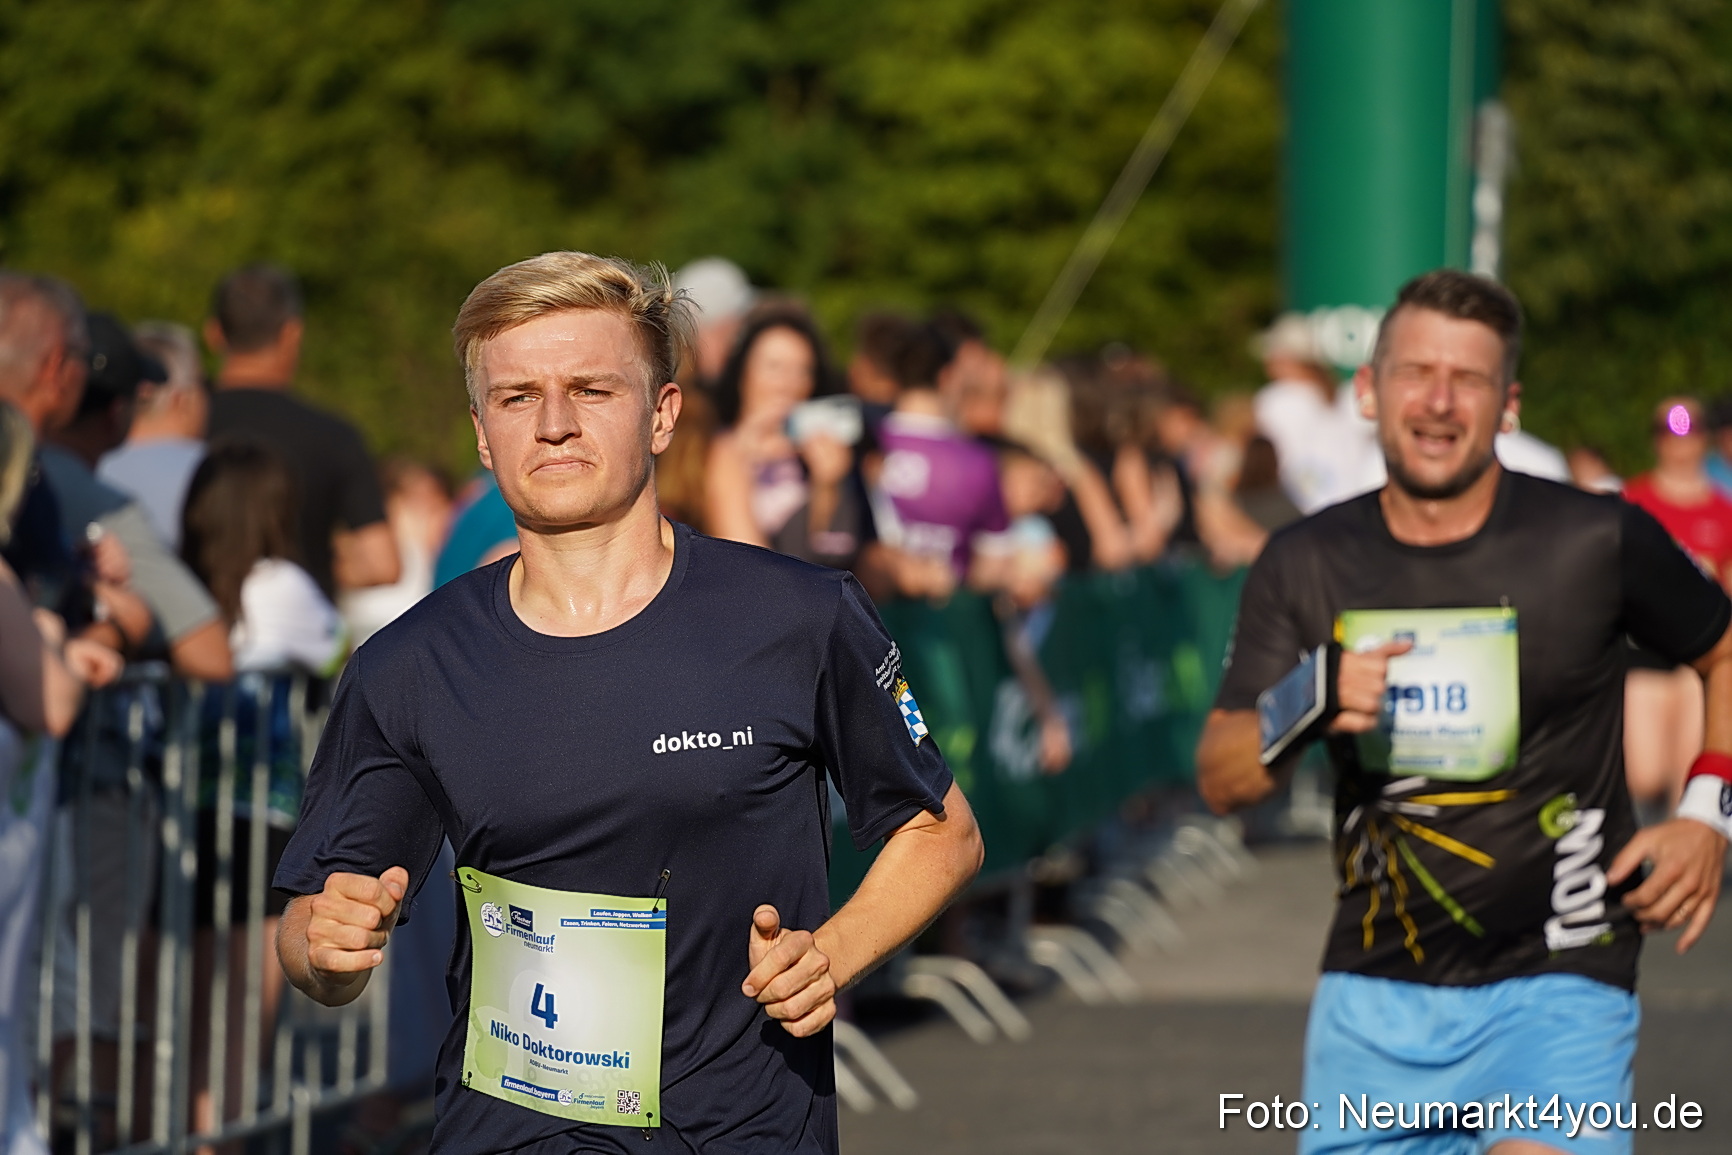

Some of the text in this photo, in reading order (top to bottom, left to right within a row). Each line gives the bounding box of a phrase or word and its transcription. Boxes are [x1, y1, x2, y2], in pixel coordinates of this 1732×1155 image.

[652, 726, 753, 754] dokto_ni
[505, 922, 556, 946] Firmenlauf
[524, 940, 554, 954] neumarkt
[531, 982, 558, 1029] 4
[490, 1020, 630, 1069] Niko Doktorowski
[504, 1078, 556, 1100] firmenlauf.bayern
[573, 1097, 605, 1106] Firmenlauf
